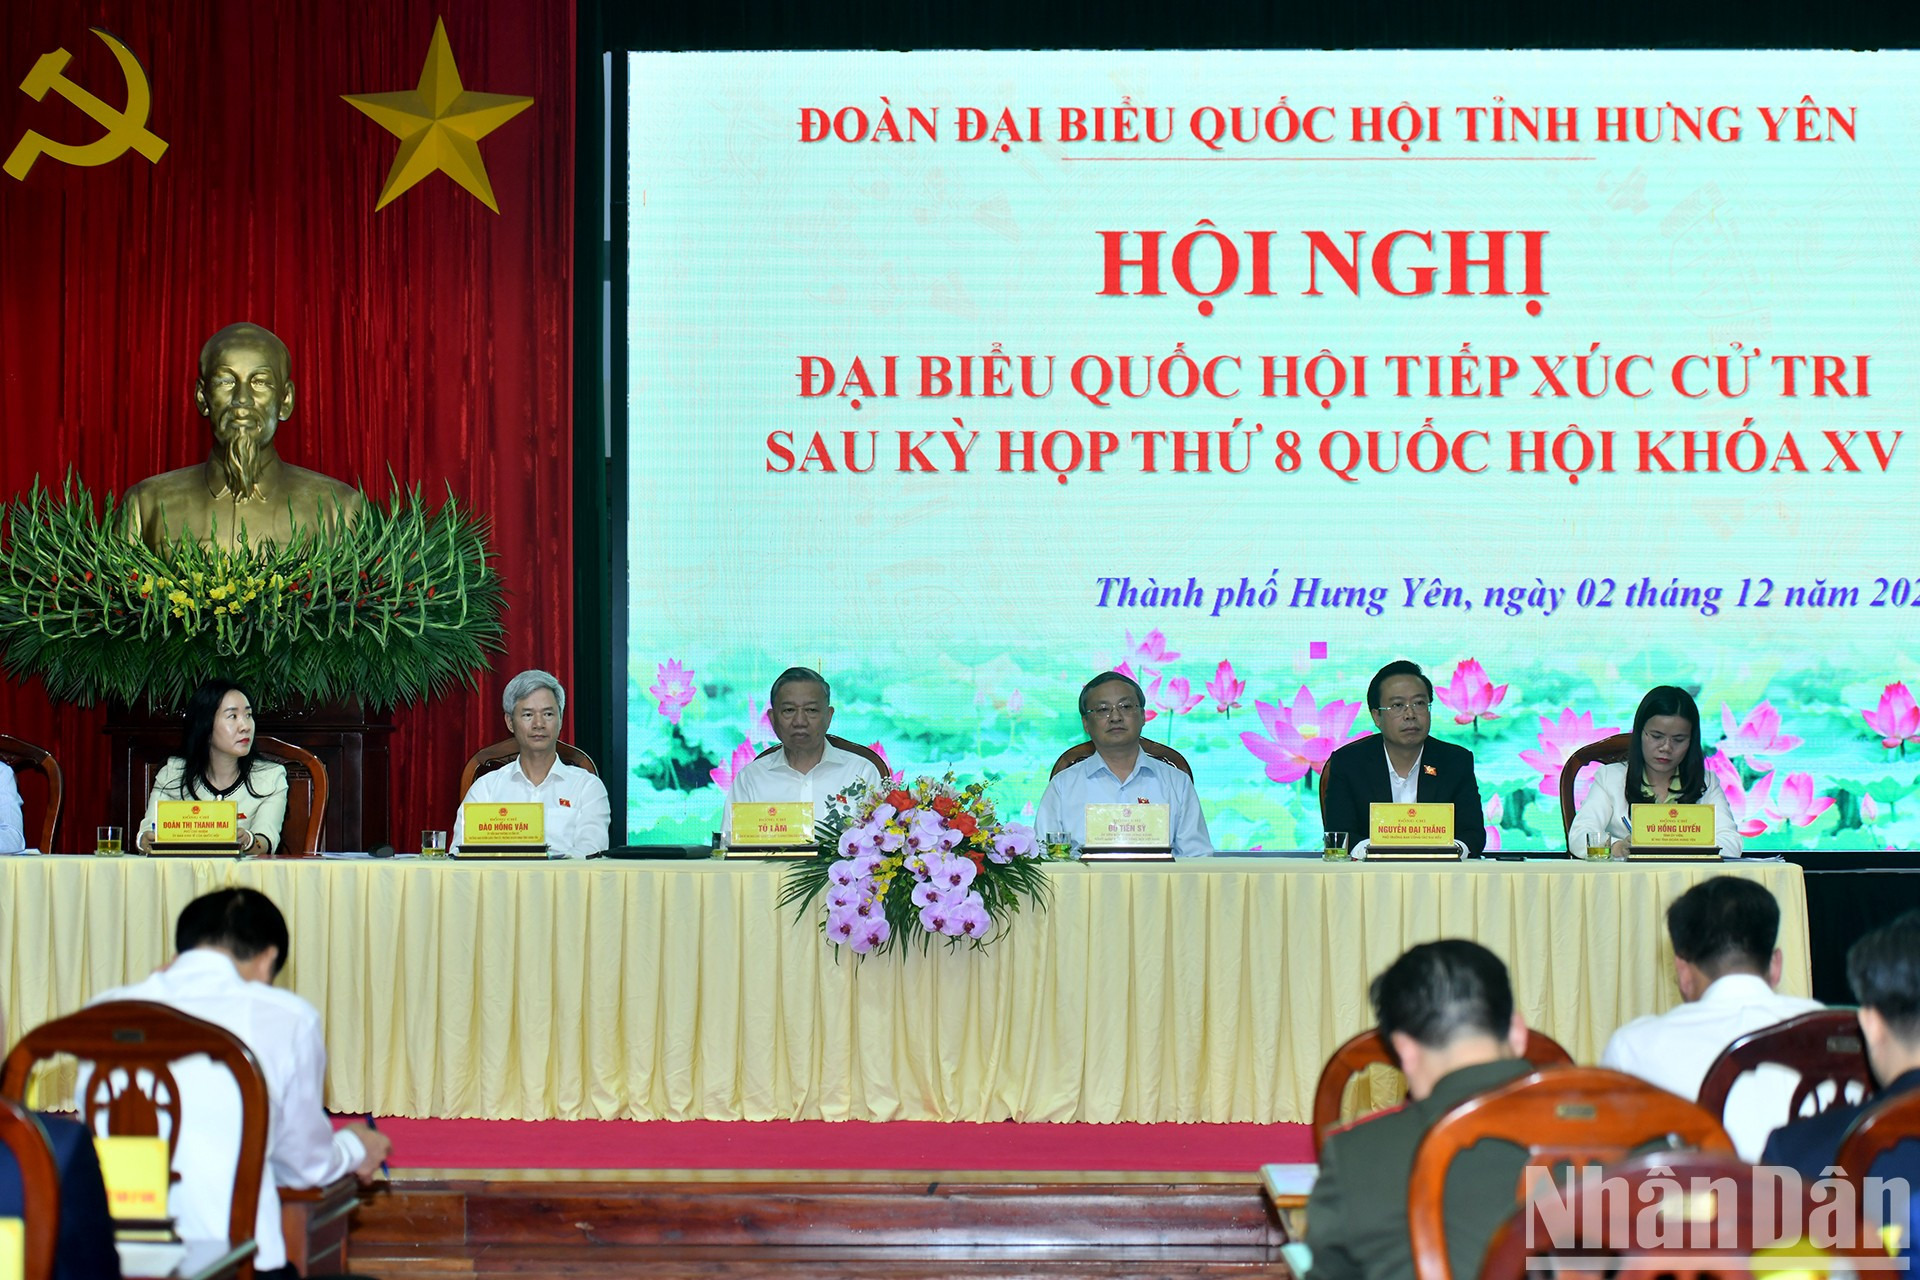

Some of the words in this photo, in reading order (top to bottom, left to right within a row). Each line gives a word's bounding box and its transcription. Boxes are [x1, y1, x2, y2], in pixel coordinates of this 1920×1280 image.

[798, 96, 938, 143] ĐOÀN
[956, 106, 1042, 152] ĐẠI
[1059, 95, 1175, 143] BIỂU
[1189, 95, 1336, 150] QUỐC
[1350, 101, 1441, 152] HỘI
[1455, 95, 1578, 143] TỈNH
[1595, 101, 1741, 143] HƯNG
[1756, 94, 1857, 143] YÊN
[1096, 218, 1277, 317] HỘI
[1301, 229, 1550, 317] NGHỊ
[796, 354, 897, 410] ĐẠI
[917, 342, 1055, 398] BIỂU
[1069, 342, 1242, 407] QUỐC
[1259, 349, 1368, 410] HỘI
[1385, 342, 1520, 398] TIẾP
[1530, 341, 1654, 398] XÚC
[1671, 341, 1761, 398] CỬ
[1770, 354, 1872, 398] TRI
[765, 429, 877, 474] SAU
[896, 417, 979, 474] KỲ
[997, 429, 1120, 485] HỌP
[1131, 417, 1264, 474] THỨ
[1274, 429, 1303, 474] 8
[1318, 417, 1490, 482] QUỐC
[1508, 424, 1615, 485] HỘI
[1636, 417, 1808, 474] KHÓA
[1820, 429, 1904, 474] XV
[1096, 576, 1205, 609] Thành
[1209, 567, 1280, 618] phố
[1288, 576, 1390, 617] Hưng
[1402, 576, 1473, 613] Yên,
[1482, 577, 1566, 617] ngày
[1575, 576, 1617, 608] 02
[1624, 576, 1724, 617] tháng
[1735, 577, 1775, 608] 12
[1783, 578, 1860, 608] năm
[182, 821, 192, 830] THỊ
[194, 821, 214, 829] THANH
[216, 821, 229, 829] MAI
